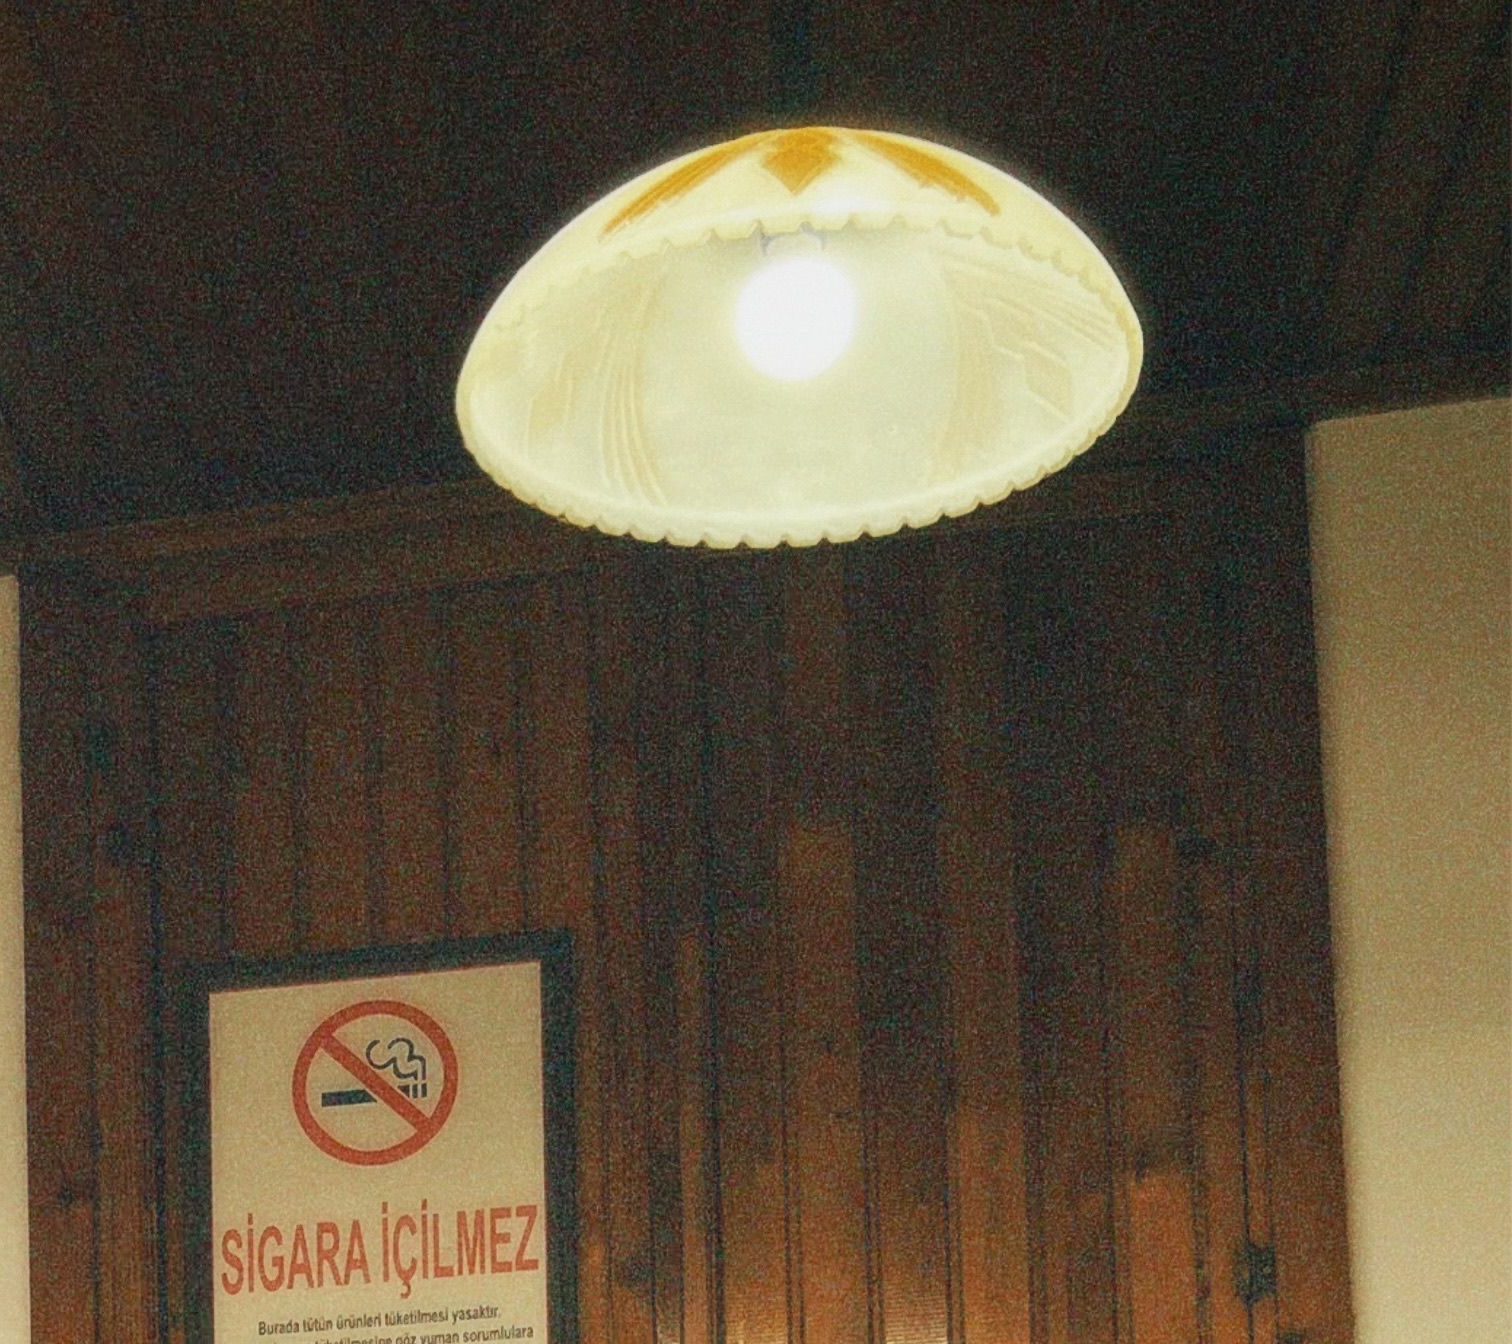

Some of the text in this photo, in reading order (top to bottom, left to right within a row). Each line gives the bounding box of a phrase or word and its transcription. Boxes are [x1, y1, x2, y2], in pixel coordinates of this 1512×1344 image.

[221, 1198, 539, 1299] SİGARA İÇİLMEZ
[258, 1319, 300, 1336] Burada
[303, 1317, 333, 1333] tütün
[336, 1313, 382, 1331] ürünleri
[385, 1309, 448, 1326] tüketilmesi
[462, 1326, 534, 1342] sorumlulara
